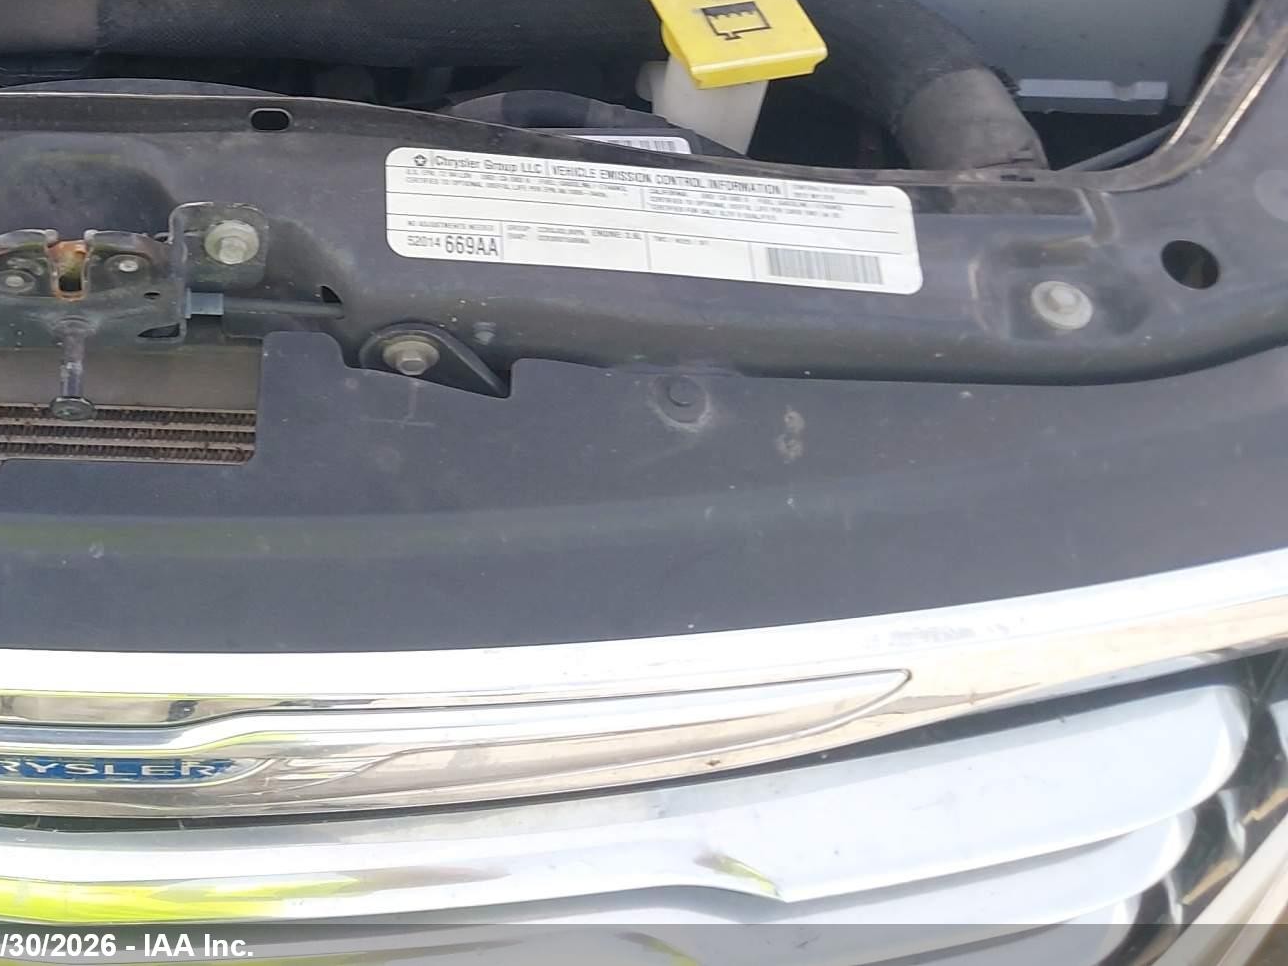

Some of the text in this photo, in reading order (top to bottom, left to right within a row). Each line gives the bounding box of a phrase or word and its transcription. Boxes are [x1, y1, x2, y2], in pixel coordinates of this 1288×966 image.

[435, 155, 542, 174] Chrysler Group LLC
[551, 165, 597, 179] VEHICLE
[600, 169, 653, 184] EMISSION
[655, 174, 706, 188] CONTROL
[708, 179, 782, 196] INFORMATION
[445, 235, 499, 256] 669AA
